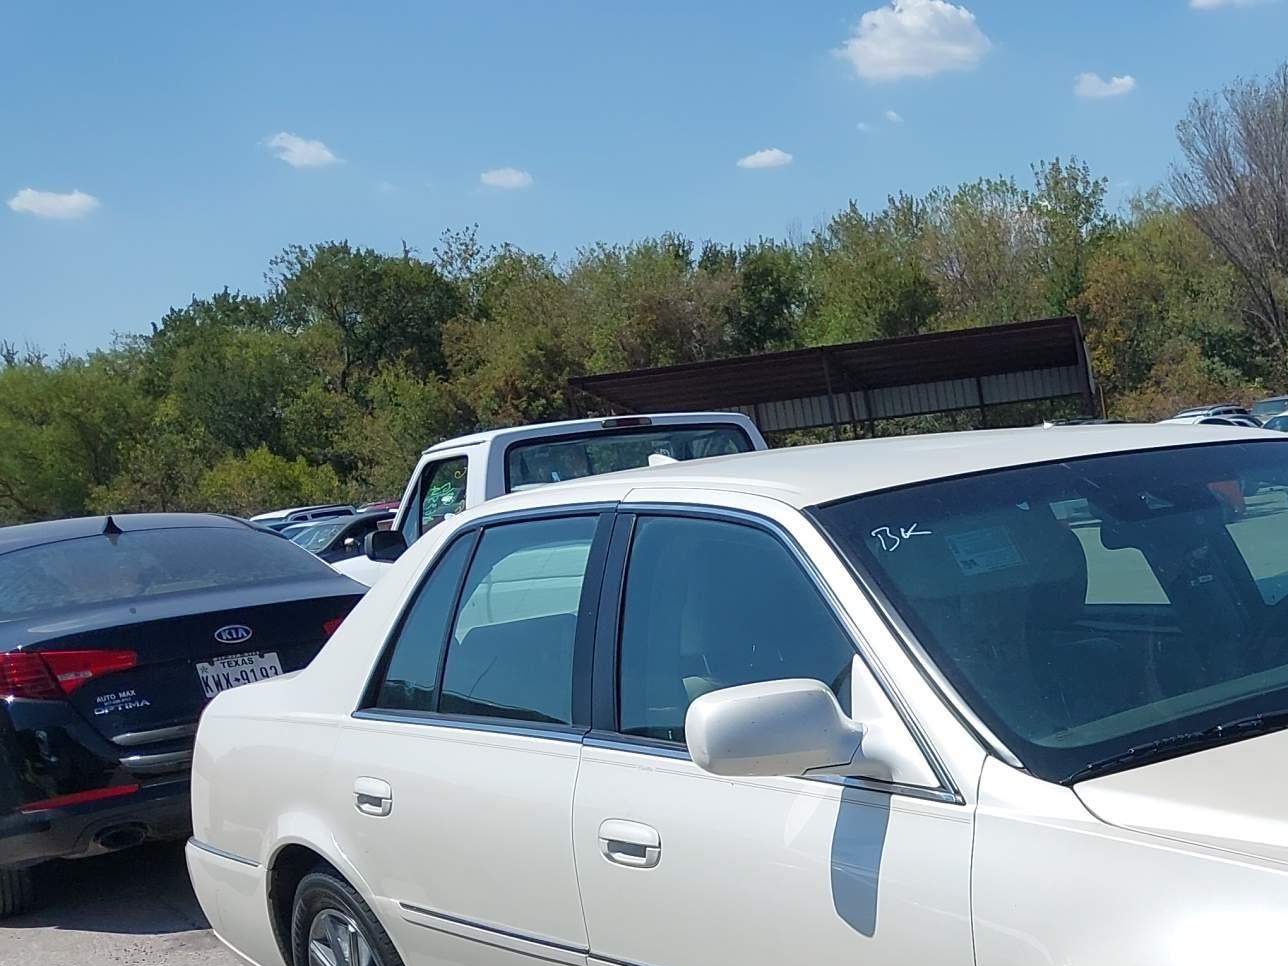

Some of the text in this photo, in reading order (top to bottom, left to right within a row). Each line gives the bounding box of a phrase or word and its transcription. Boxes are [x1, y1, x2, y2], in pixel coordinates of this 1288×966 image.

[218, 627, 249, 641] KIA
[220, 656, 255, 669] TEXAS
[96, 694, 116, 703] AUTO
[118, 689, 137, 698] MAX
[93, 699, 151, 715] OPTIMA
